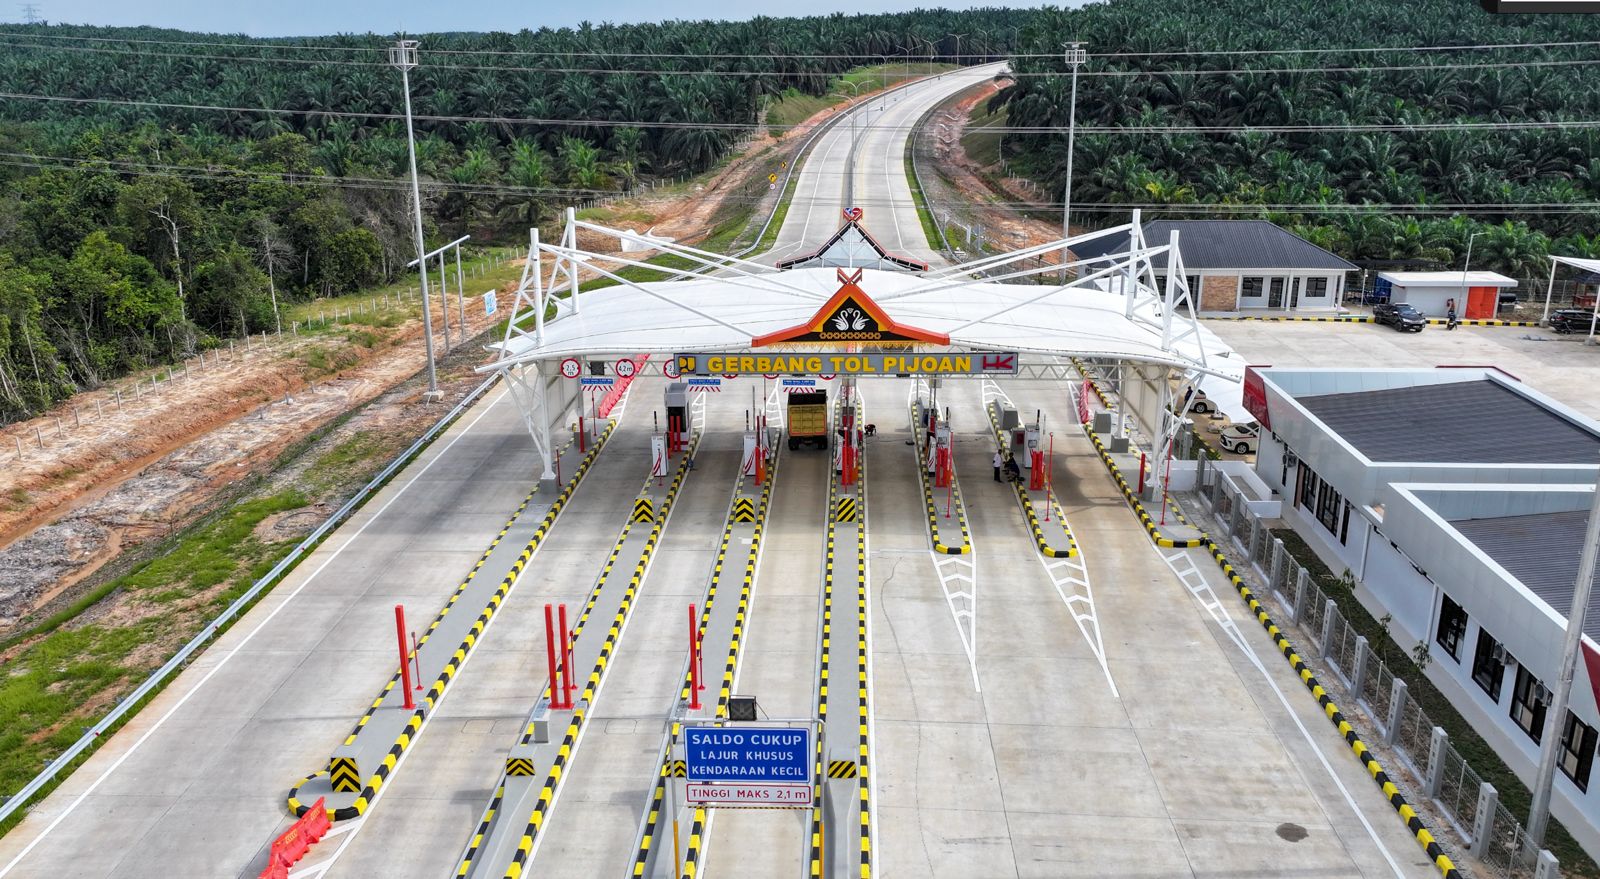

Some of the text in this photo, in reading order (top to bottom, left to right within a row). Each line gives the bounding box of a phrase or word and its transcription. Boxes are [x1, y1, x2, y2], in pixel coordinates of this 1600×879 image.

[707, 356, 971, 372] GERBANG TOL PIJOAN
[692, 734, 802, 745] SALDO CUKUP
[700, 751, 794, 760] LAJUR KHUSUS
[692, 766, 804, 776] KENDARAAN KECIL
[692, 789, 730, 797] TINGGI
[737, 789, 770, 798] MAKS
[776, 790, 791, 799] 2,1
